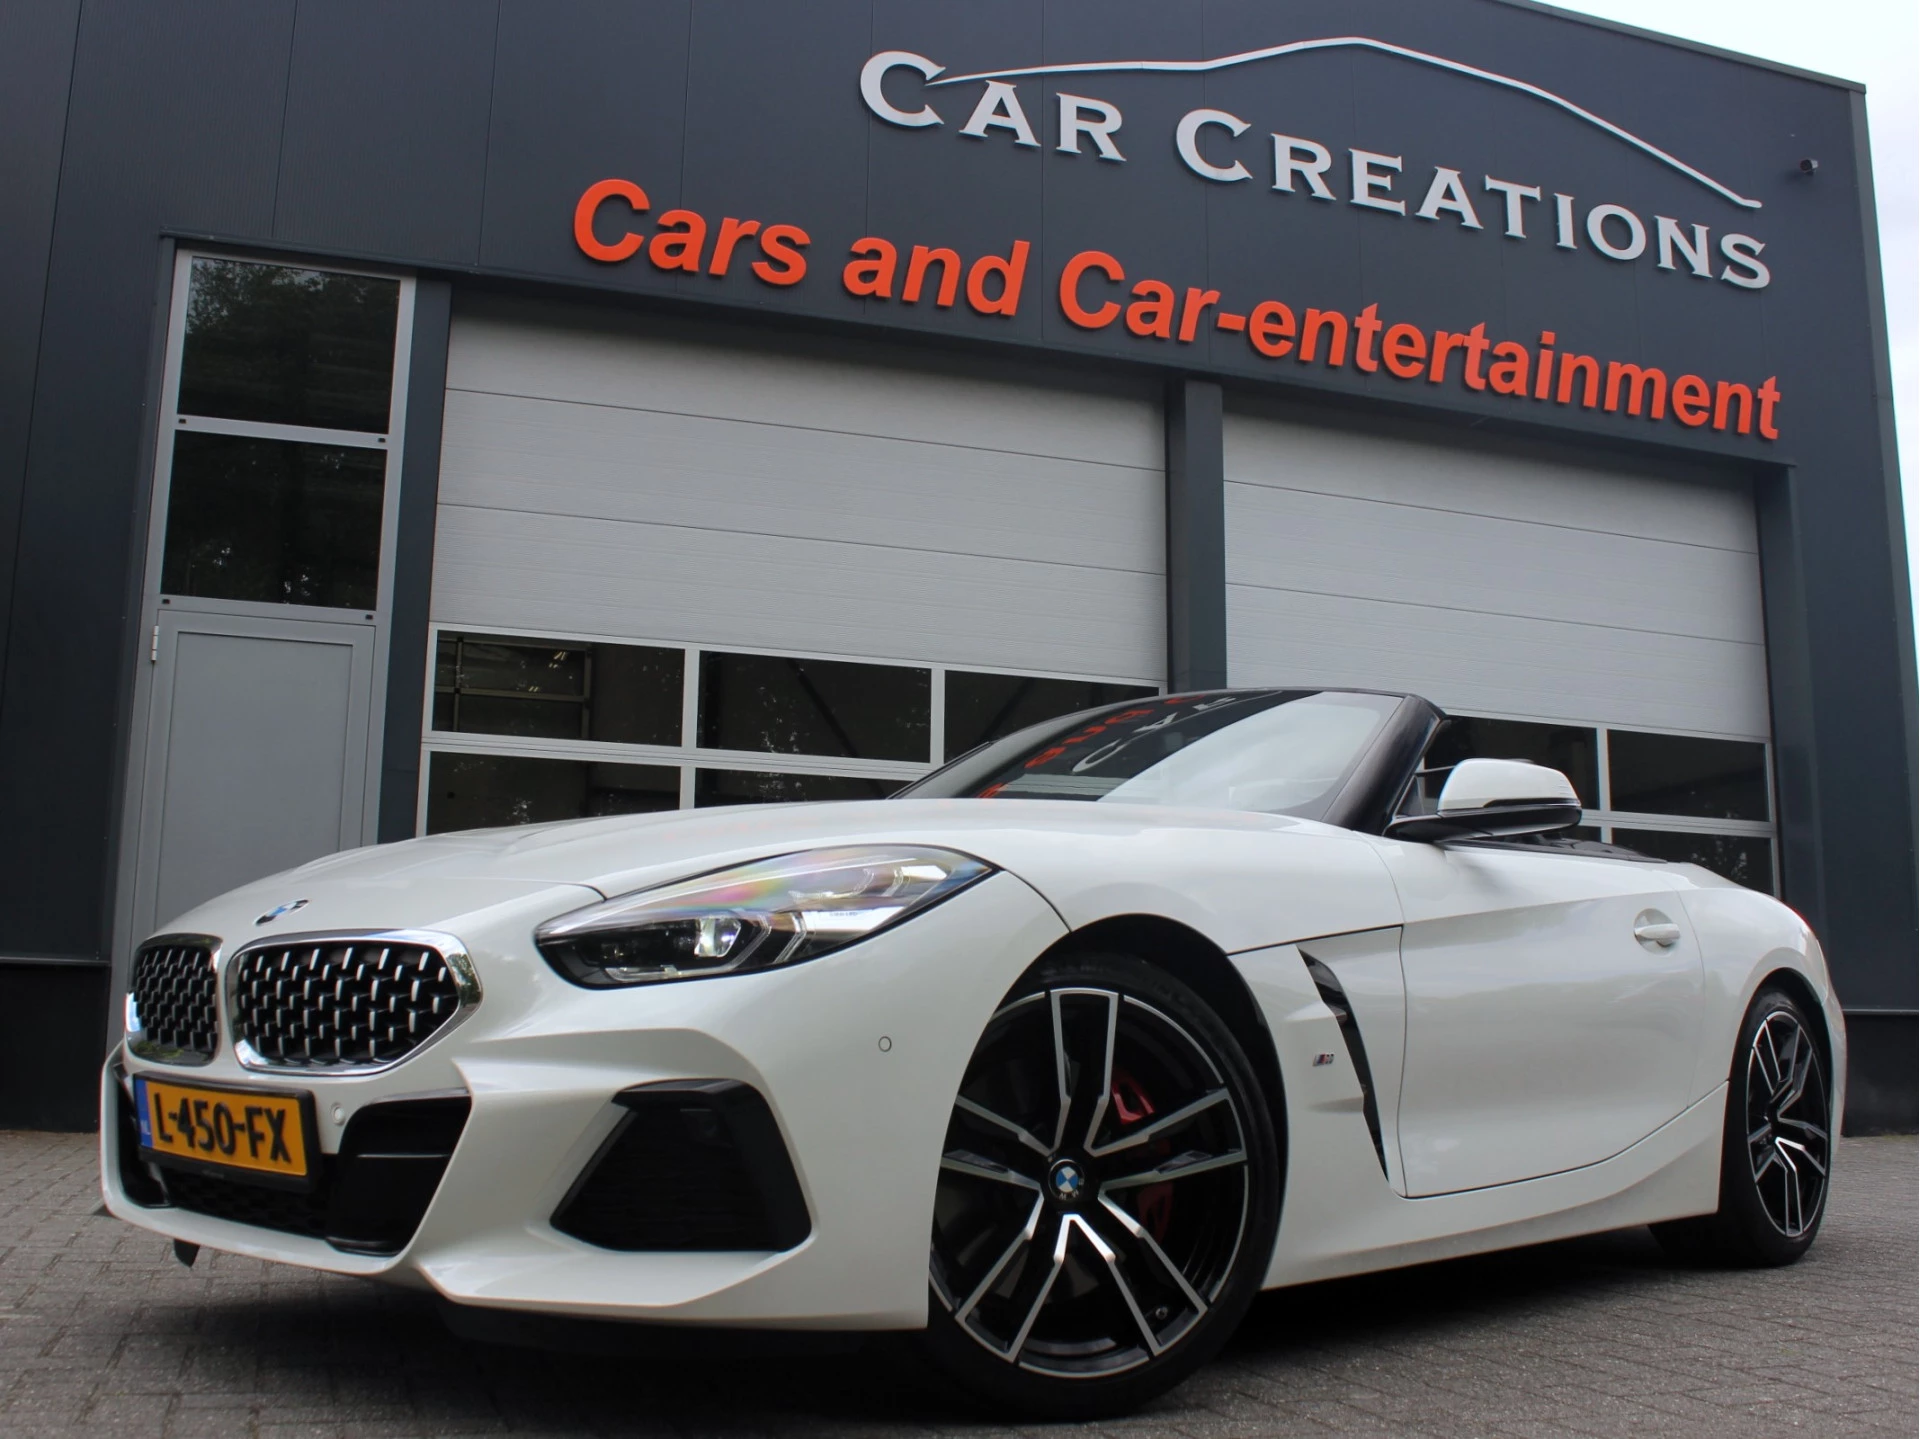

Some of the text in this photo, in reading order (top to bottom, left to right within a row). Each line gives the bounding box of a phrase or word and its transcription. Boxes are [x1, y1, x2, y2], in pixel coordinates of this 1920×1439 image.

[861, 51, 1770, 289] CAR CREATIONS
[574, 179, 1781, 439] Cars and Car-entertainment
[154, 1092, 291, 1164] L-450-FX
